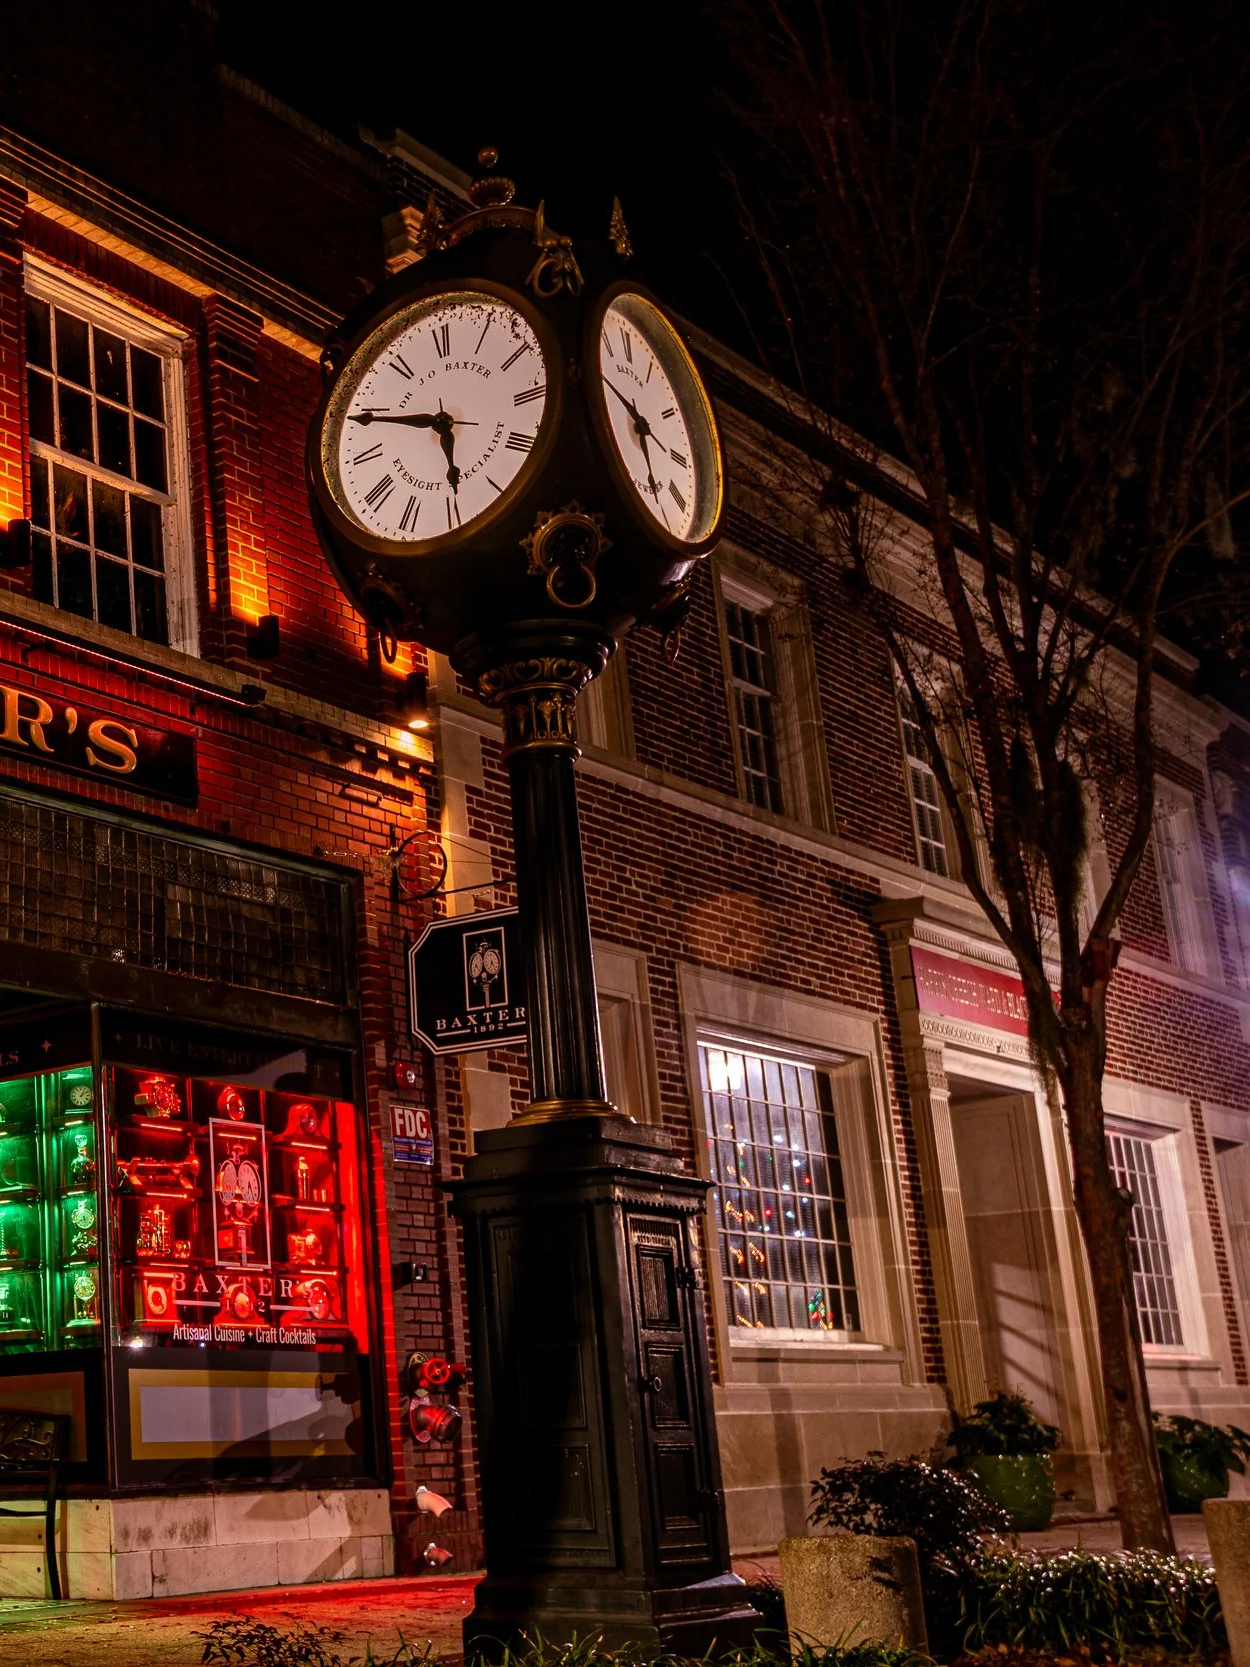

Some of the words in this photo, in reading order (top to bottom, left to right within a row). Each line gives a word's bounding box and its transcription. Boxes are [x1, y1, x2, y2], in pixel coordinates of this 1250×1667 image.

[398, 391, 413, 409] DR
[445, 361, 492, 379] BAXTER
[616, 364, 644, 389] BAXTER
[392, 457, 443, 491] EYESIGHT
[473, 1023, 504, 1034] 1892
[135, 1033, 182, 1054] LIVE
[394, 1107, 428, 1139] FDC
[173, 1323, 212, 1342] Artisanal
[214, 1326, 245, 1343] Cuisine
[255, 1327, 277, 1344] Craft
[279, 1329, 317, 1345] Cocktails
